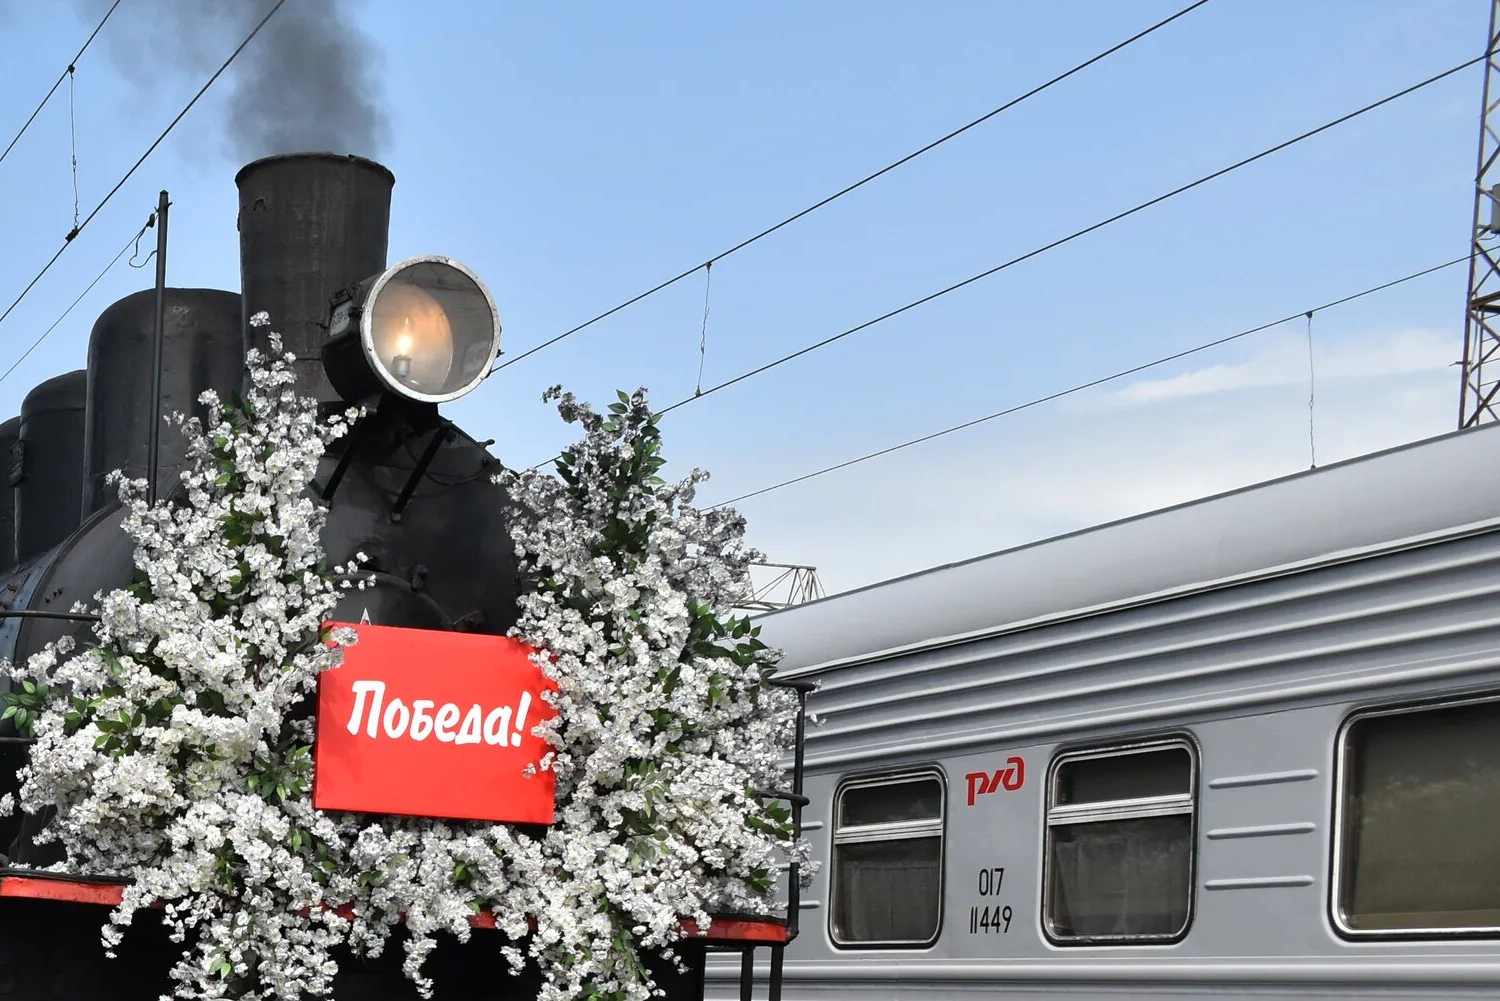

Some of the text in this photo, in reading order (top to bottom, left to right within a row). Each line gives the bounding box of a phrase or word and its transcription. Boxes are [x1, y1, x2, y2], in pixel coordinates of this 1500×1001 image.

[347, 680, 532, 747] Победа!
[979, 868, 1005, 896] 017
[970, 906, 1012, 934] 11449
